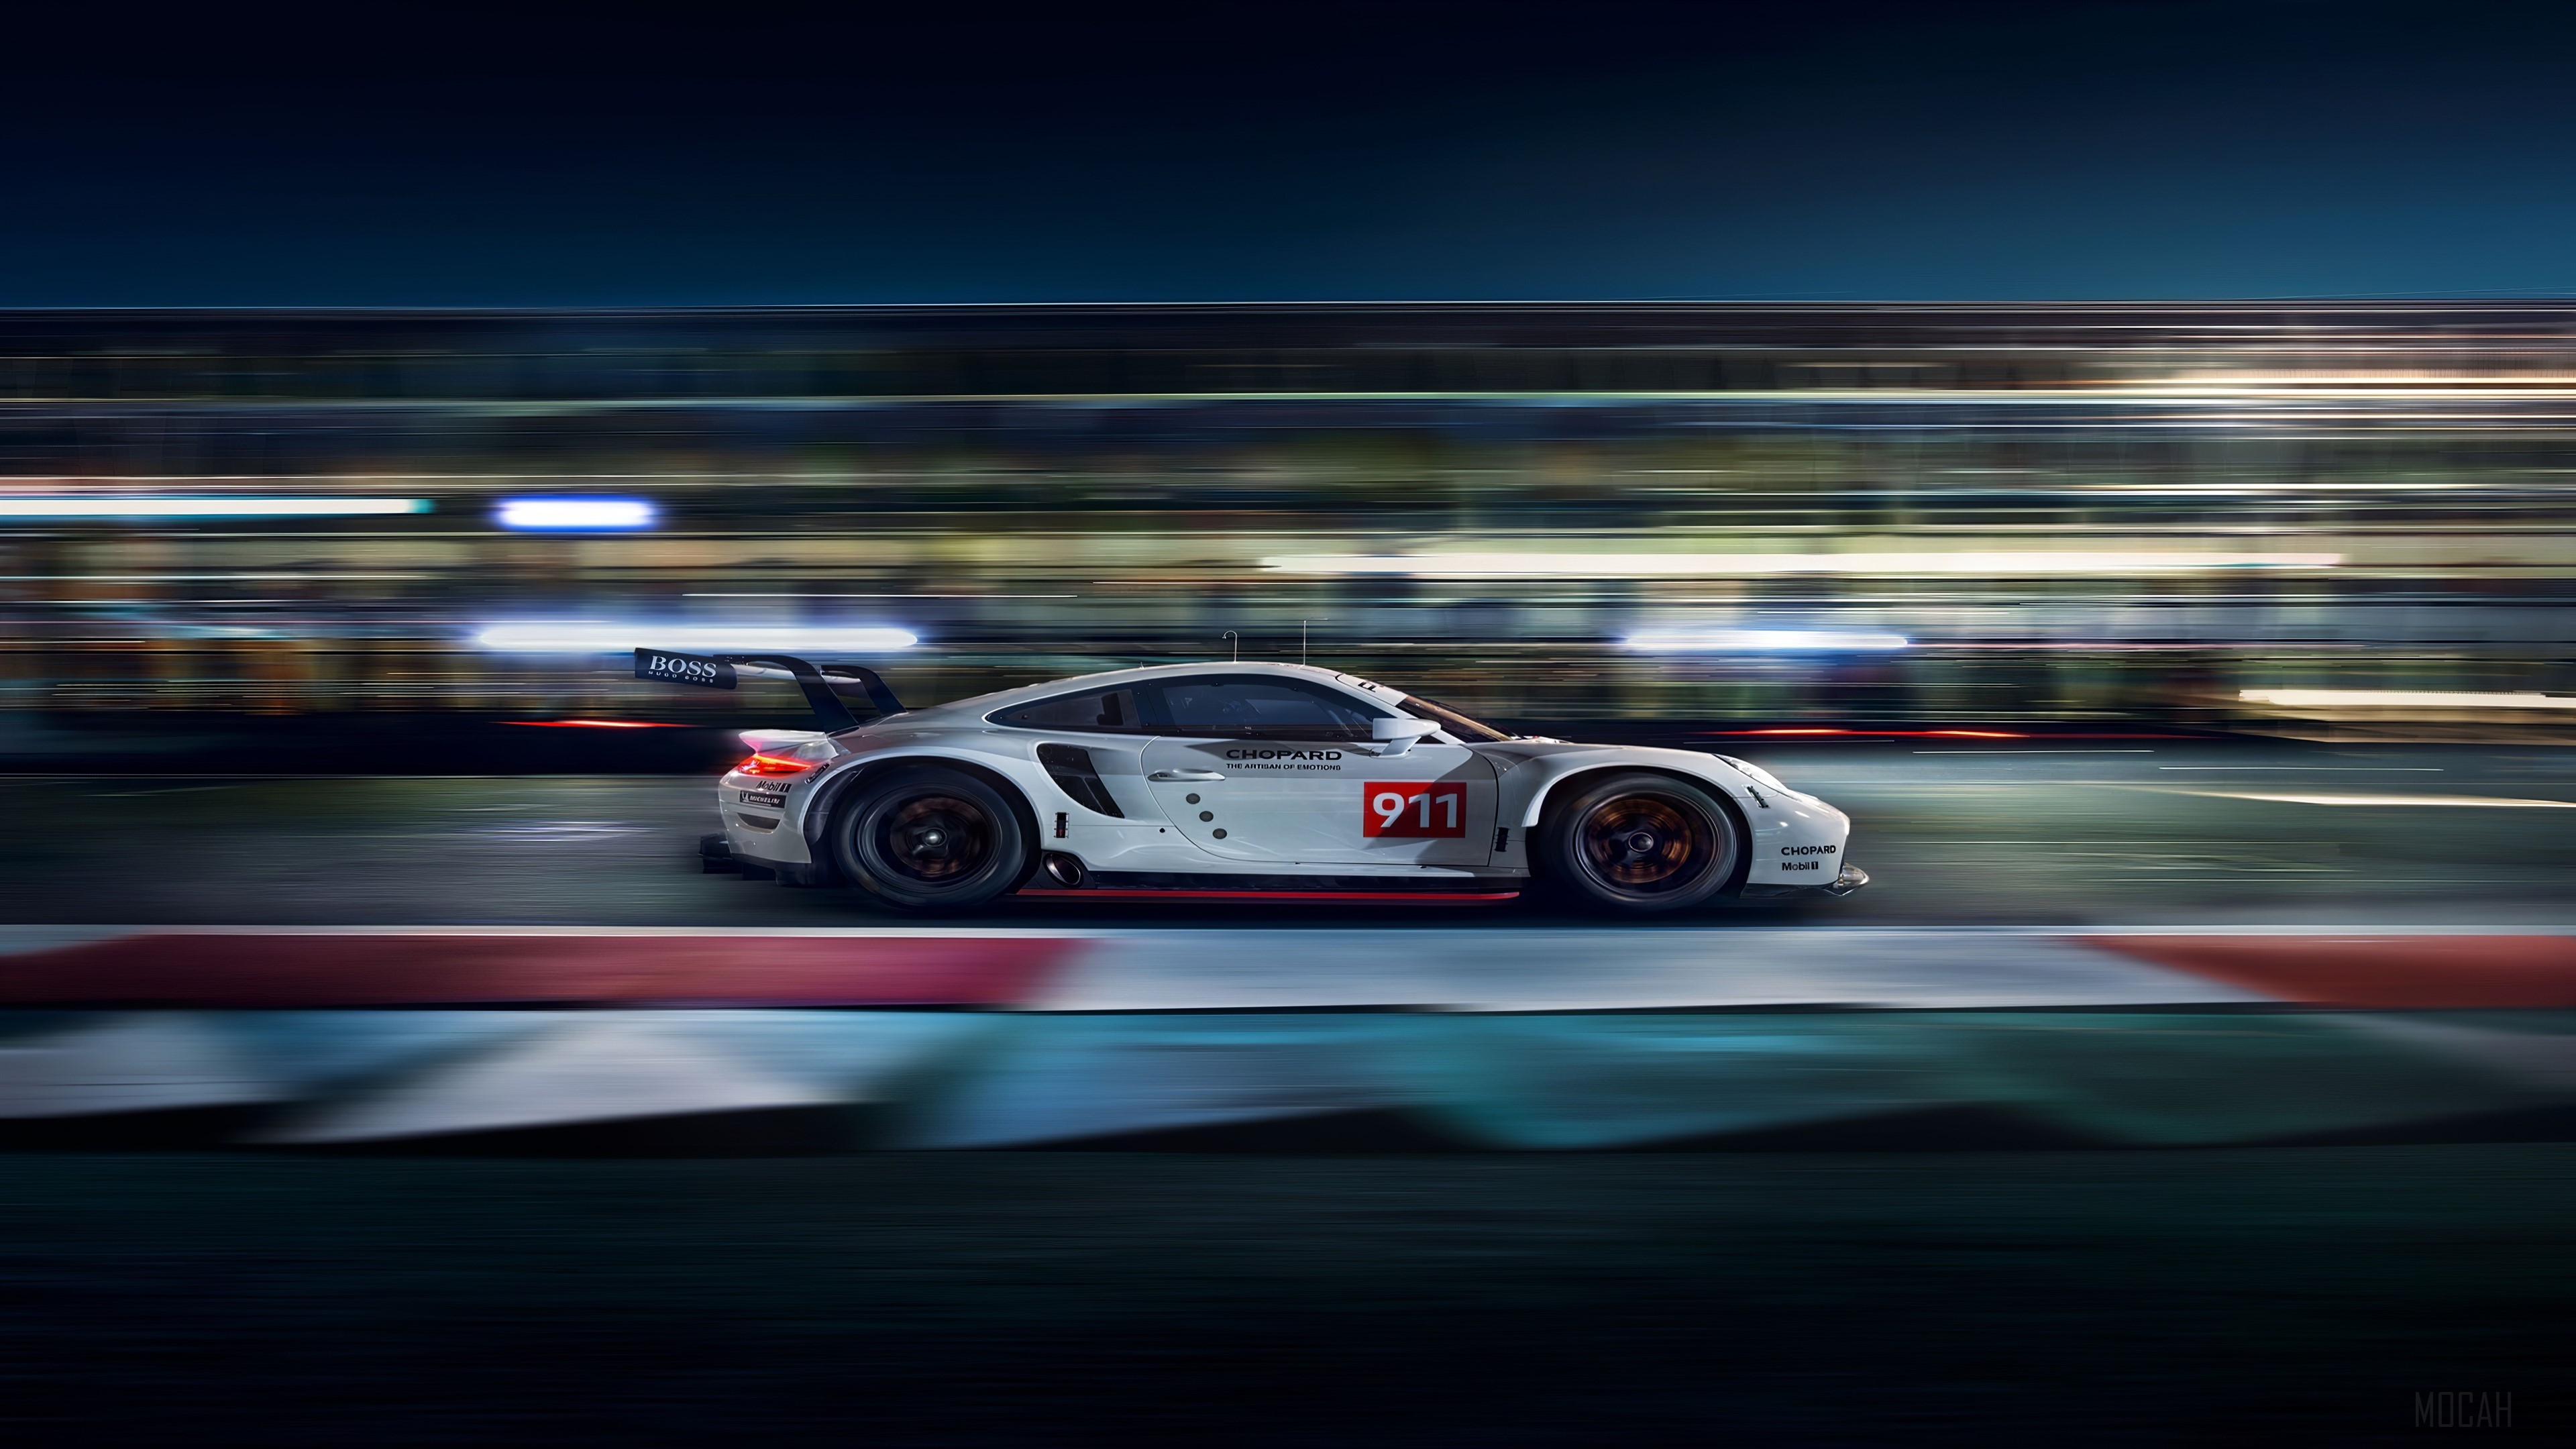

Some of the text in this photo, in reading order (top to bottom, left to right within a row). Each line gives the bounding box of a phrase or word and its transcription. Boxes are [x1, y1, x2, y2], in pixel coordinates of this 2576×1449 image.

[650, 655, 716, 678] BOSS
[1226, 749, 1342, 761] CHOPARD
[1373, 792, 1458, 828] 911
[1781, 845, 1837, 856] CHOPARD
